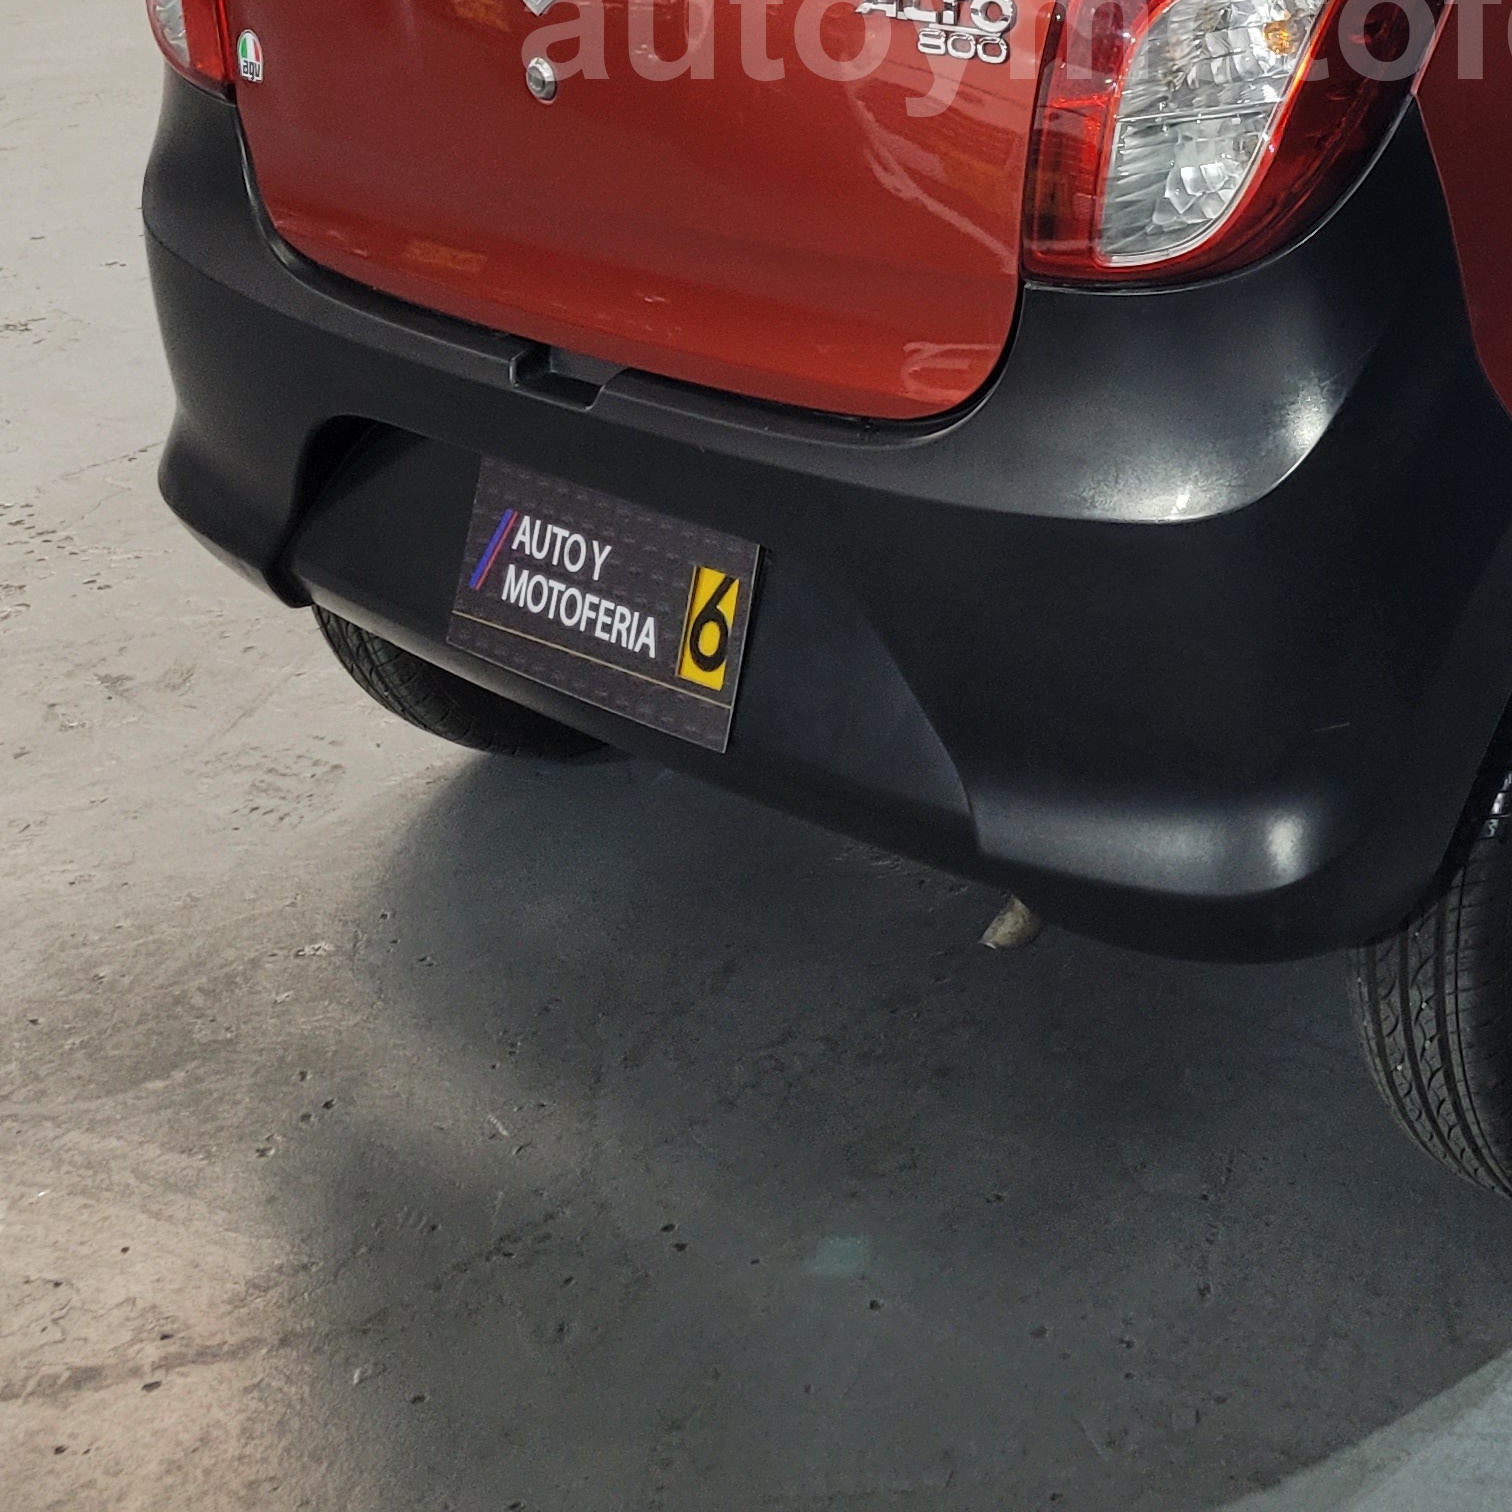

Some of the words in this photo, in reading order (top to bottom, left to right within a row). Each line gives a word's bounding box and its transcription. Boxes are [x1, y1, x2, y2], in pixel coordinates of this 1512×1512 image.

[242, 59, 261, 81] agv
[917, 27, 1009, 64] 800
[511, 515, 586, 573] AUTO
[591, 540, 612, 582] Y
[501, 564, 656, 659] MOTOFERIA
[689, 576, 738, 673] 6
